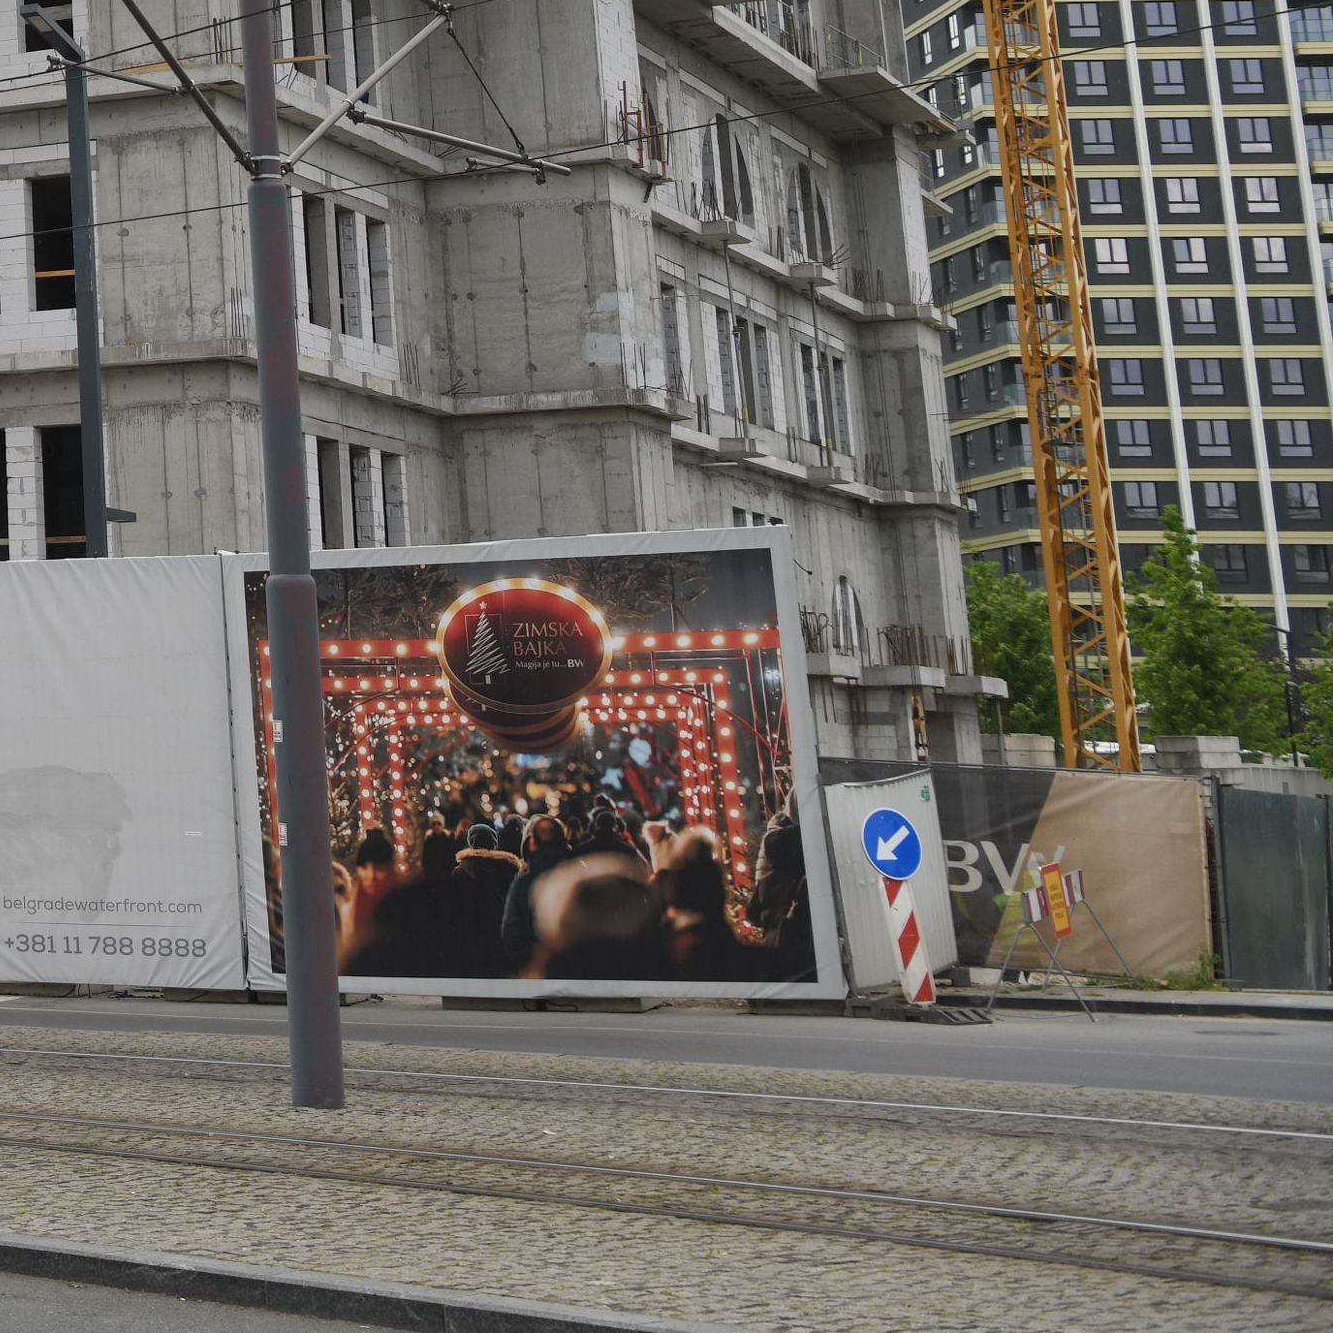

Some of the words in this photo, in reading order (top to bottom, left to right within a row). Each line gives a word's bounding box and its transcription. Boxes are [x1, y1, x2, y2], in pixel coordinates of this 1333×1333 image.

[513, 621, 583, 638] ZIMSKA
[513, 640, 568, 658] BAJKA
[515, 660, 541, 671] Magija
[3, 896, 202, 914] belgradewaterfront.com
[5, 934, 56, 953] +381
[63, 936, 82, 954] 11
[89, 936, 133, 955] 788
[142, 937, 206, 957] 8888
